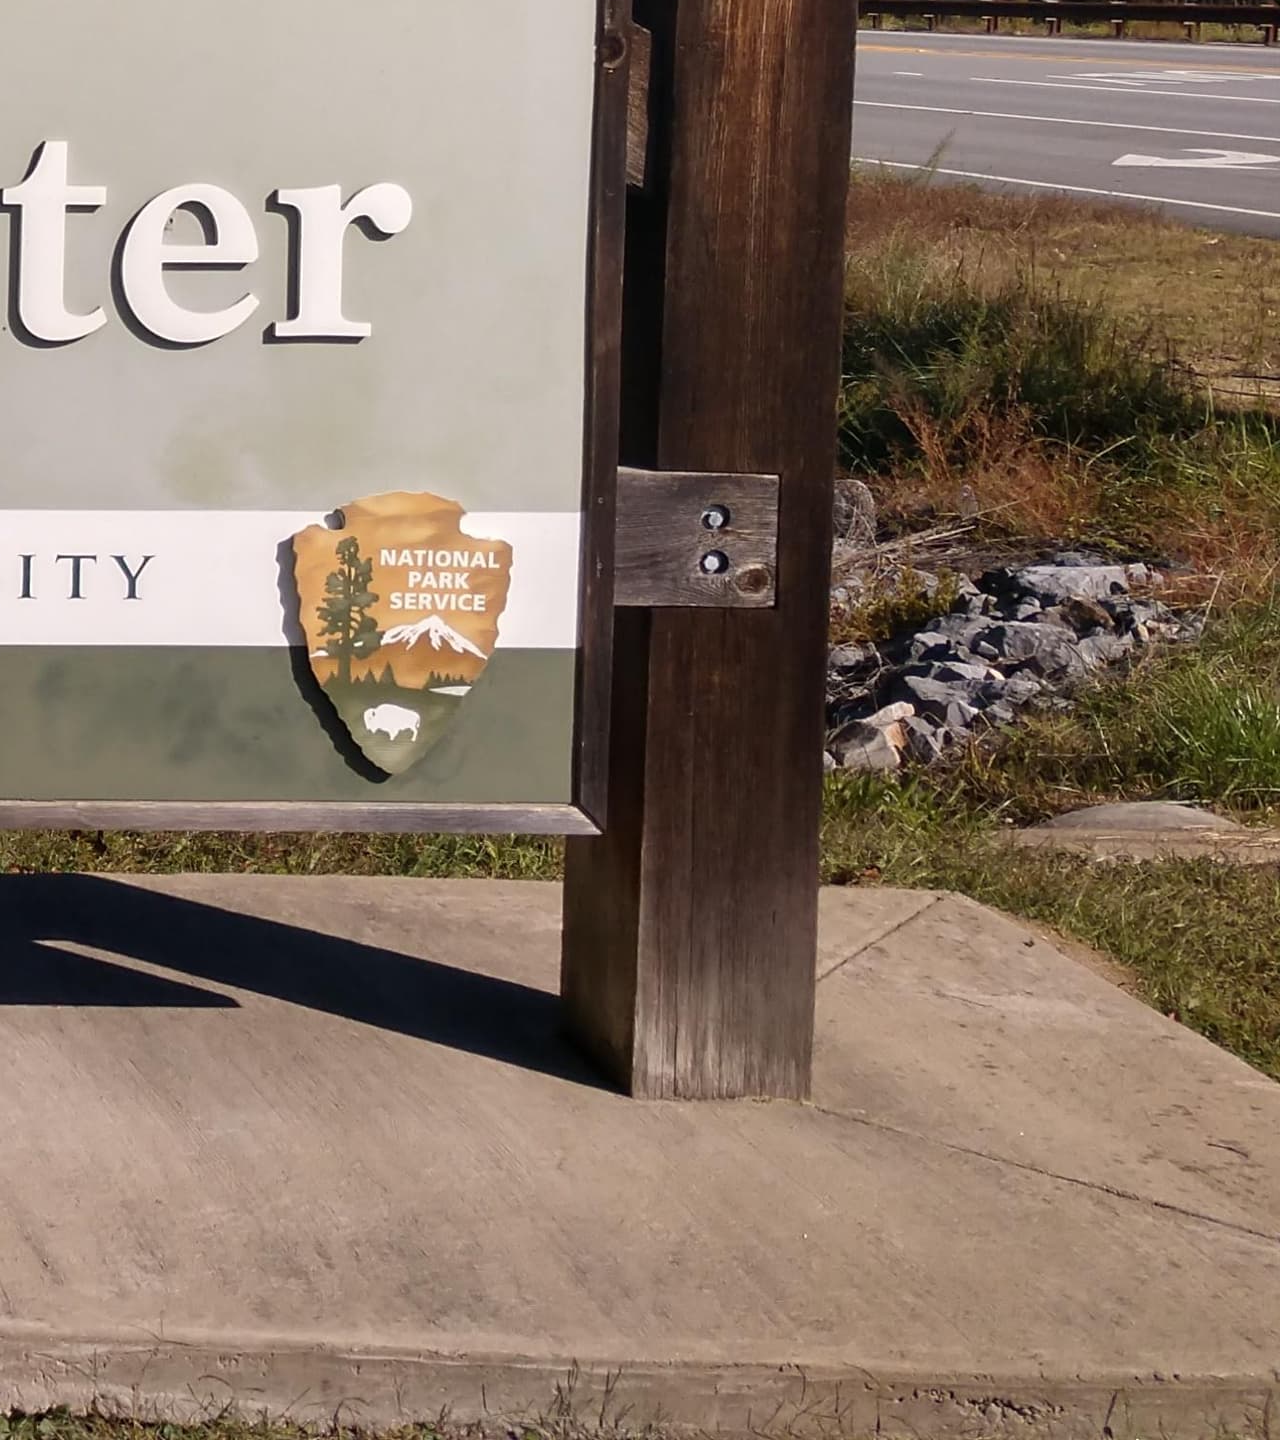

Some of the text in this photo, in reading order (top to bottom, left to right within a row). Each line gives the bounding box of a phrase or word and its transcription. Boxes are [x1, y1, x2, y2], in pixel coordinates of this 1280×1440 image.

[379, 548, 500, 569] NATIONAL
[408, 570, 469, 590] PARK
[389, 591, 486, 612] SERVICE
